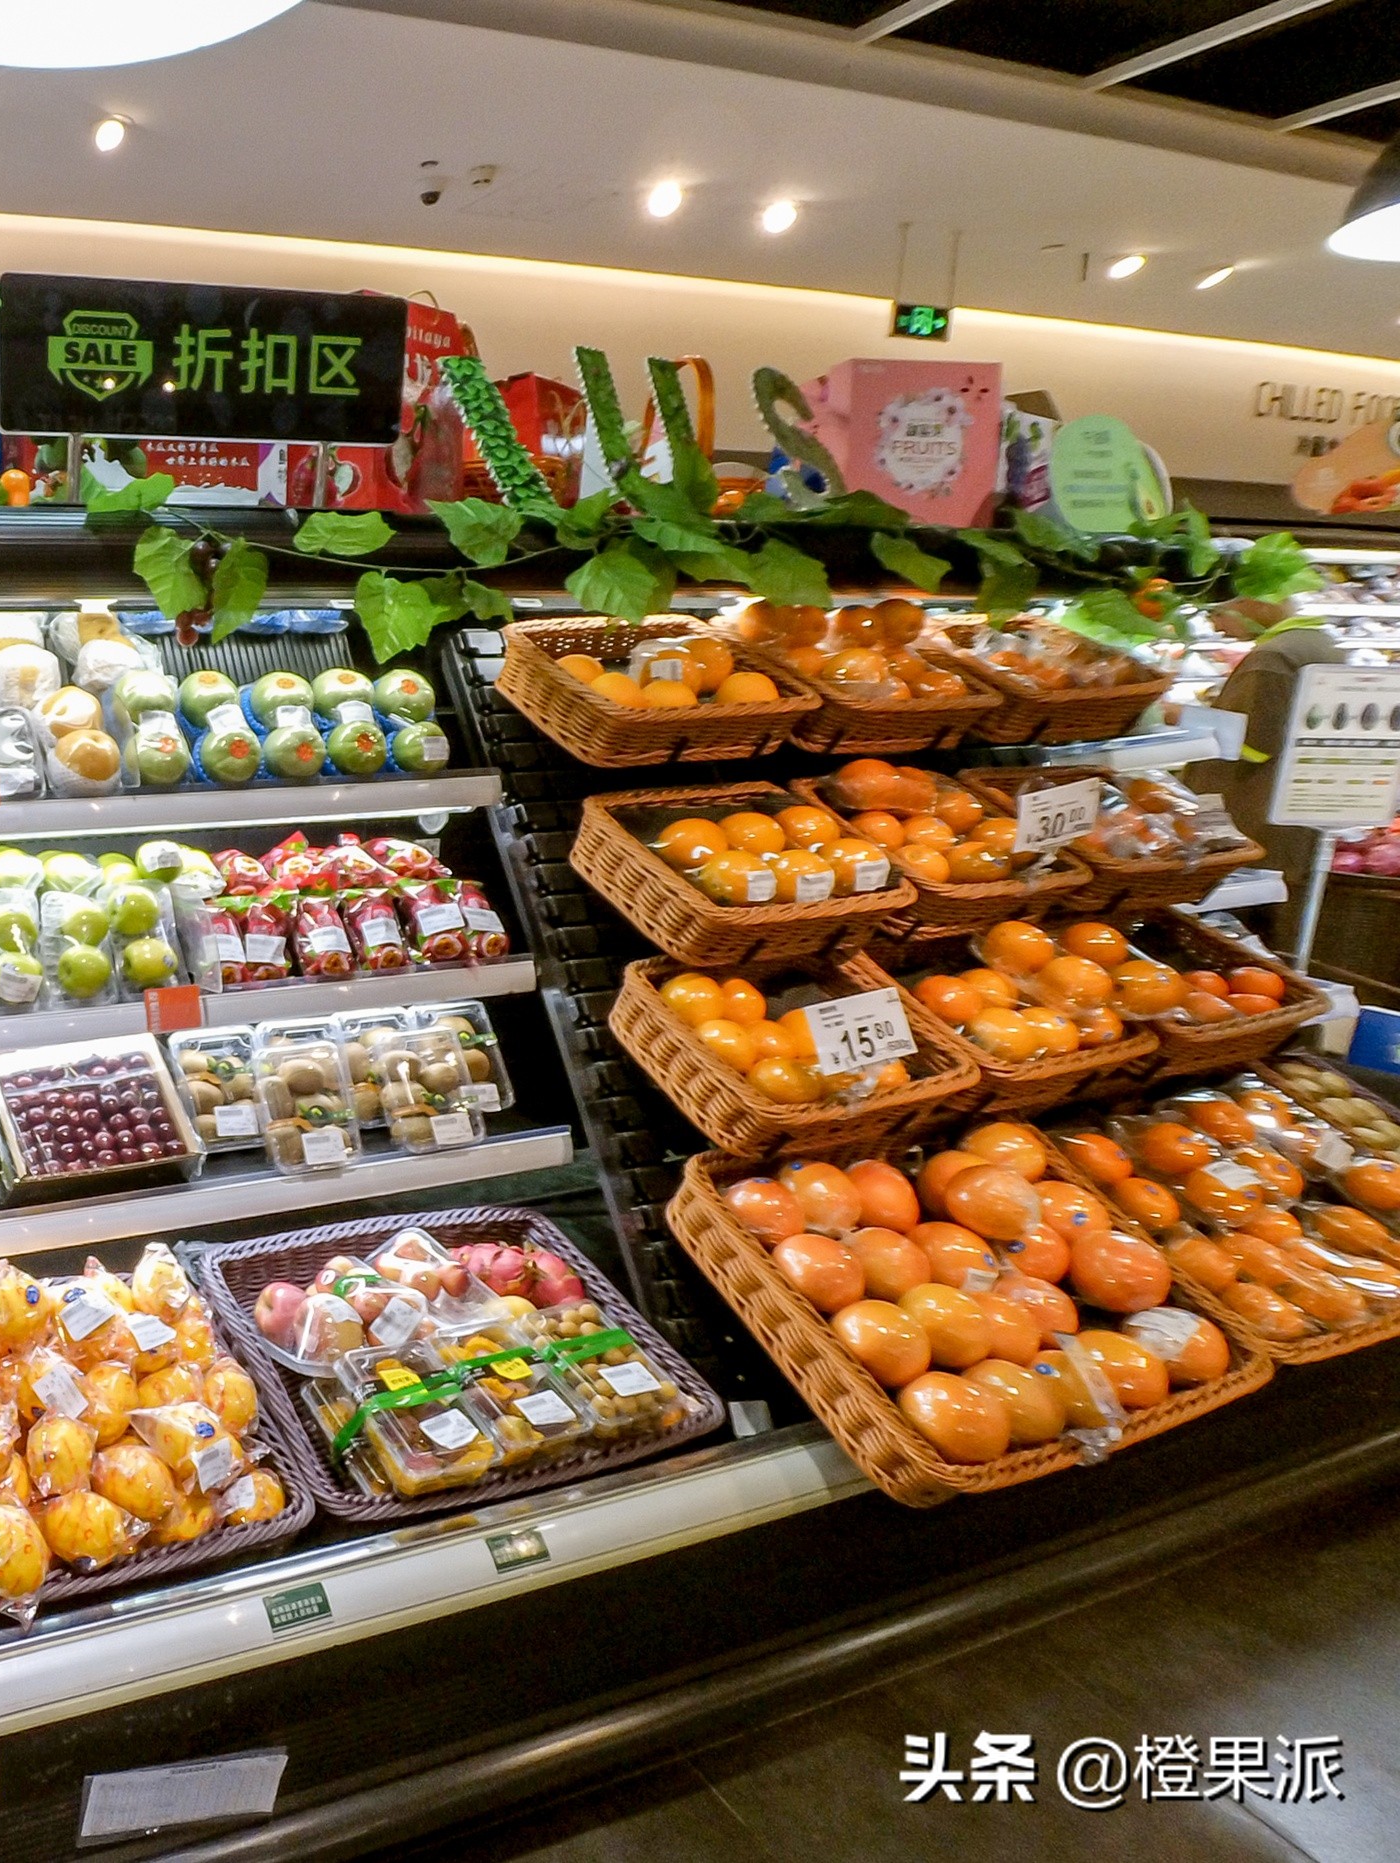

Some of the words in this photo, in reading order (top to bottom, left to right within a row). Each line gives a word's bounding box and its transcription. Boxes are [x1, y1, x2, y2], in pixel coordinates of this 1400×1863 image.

[71, 322, 130, 338] DISCOUNT
[63, 340, 138, 367] SALE
[172, 323, 363, 396] 折扣区
[1255, 380, 1344, 424] CHILLED
[892, 439, 959, 456] FRUITS
[840, 1025, 876, 1062] 15
